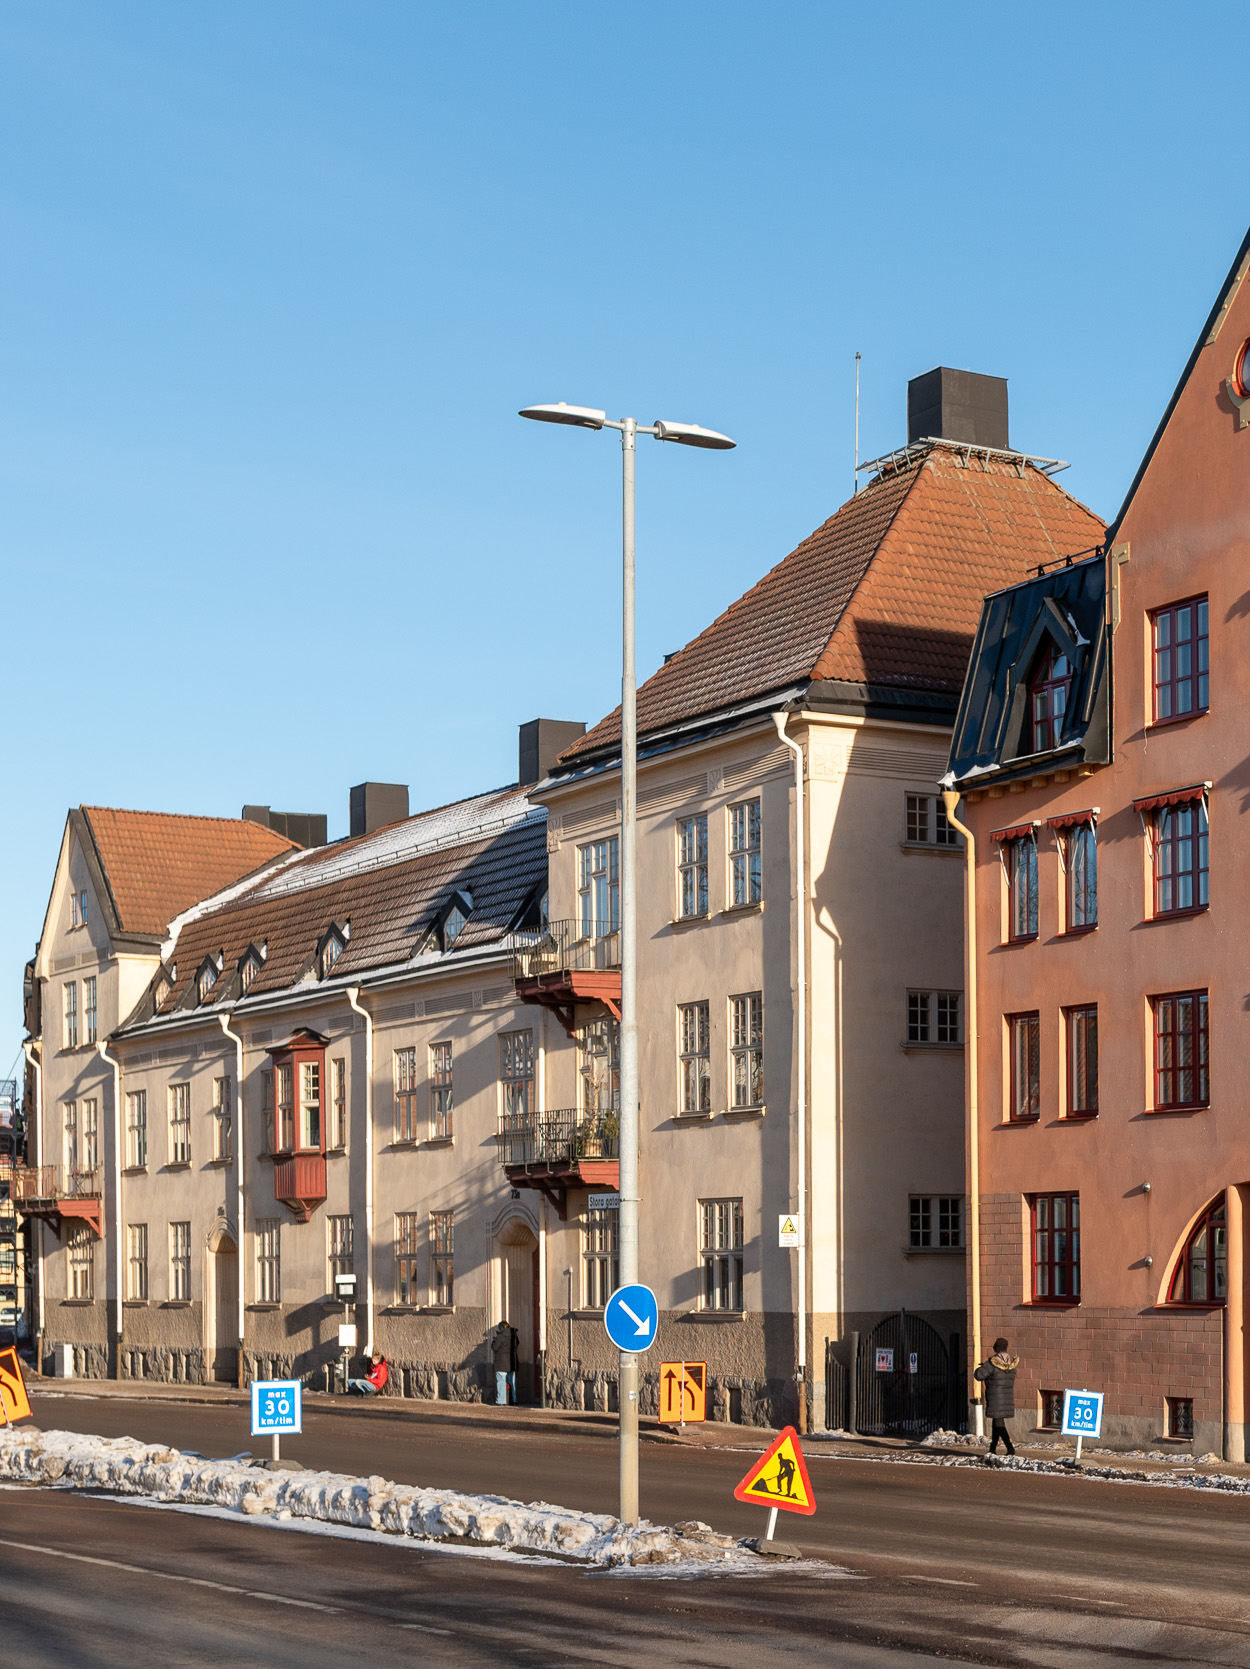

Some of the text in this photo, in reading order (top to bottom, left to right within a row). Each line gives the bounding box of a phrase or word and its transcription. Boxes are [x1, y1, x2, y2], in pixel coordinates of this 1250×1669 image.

[589, 1196, 605, 1207] Stora
[264, 1399, 290, 1416] 30
[1074, 1407, 1093, 1420] 30
[261, 1416, 293, 1425] km/tim
[1071, 1420, 1094, 1429] km/tim
